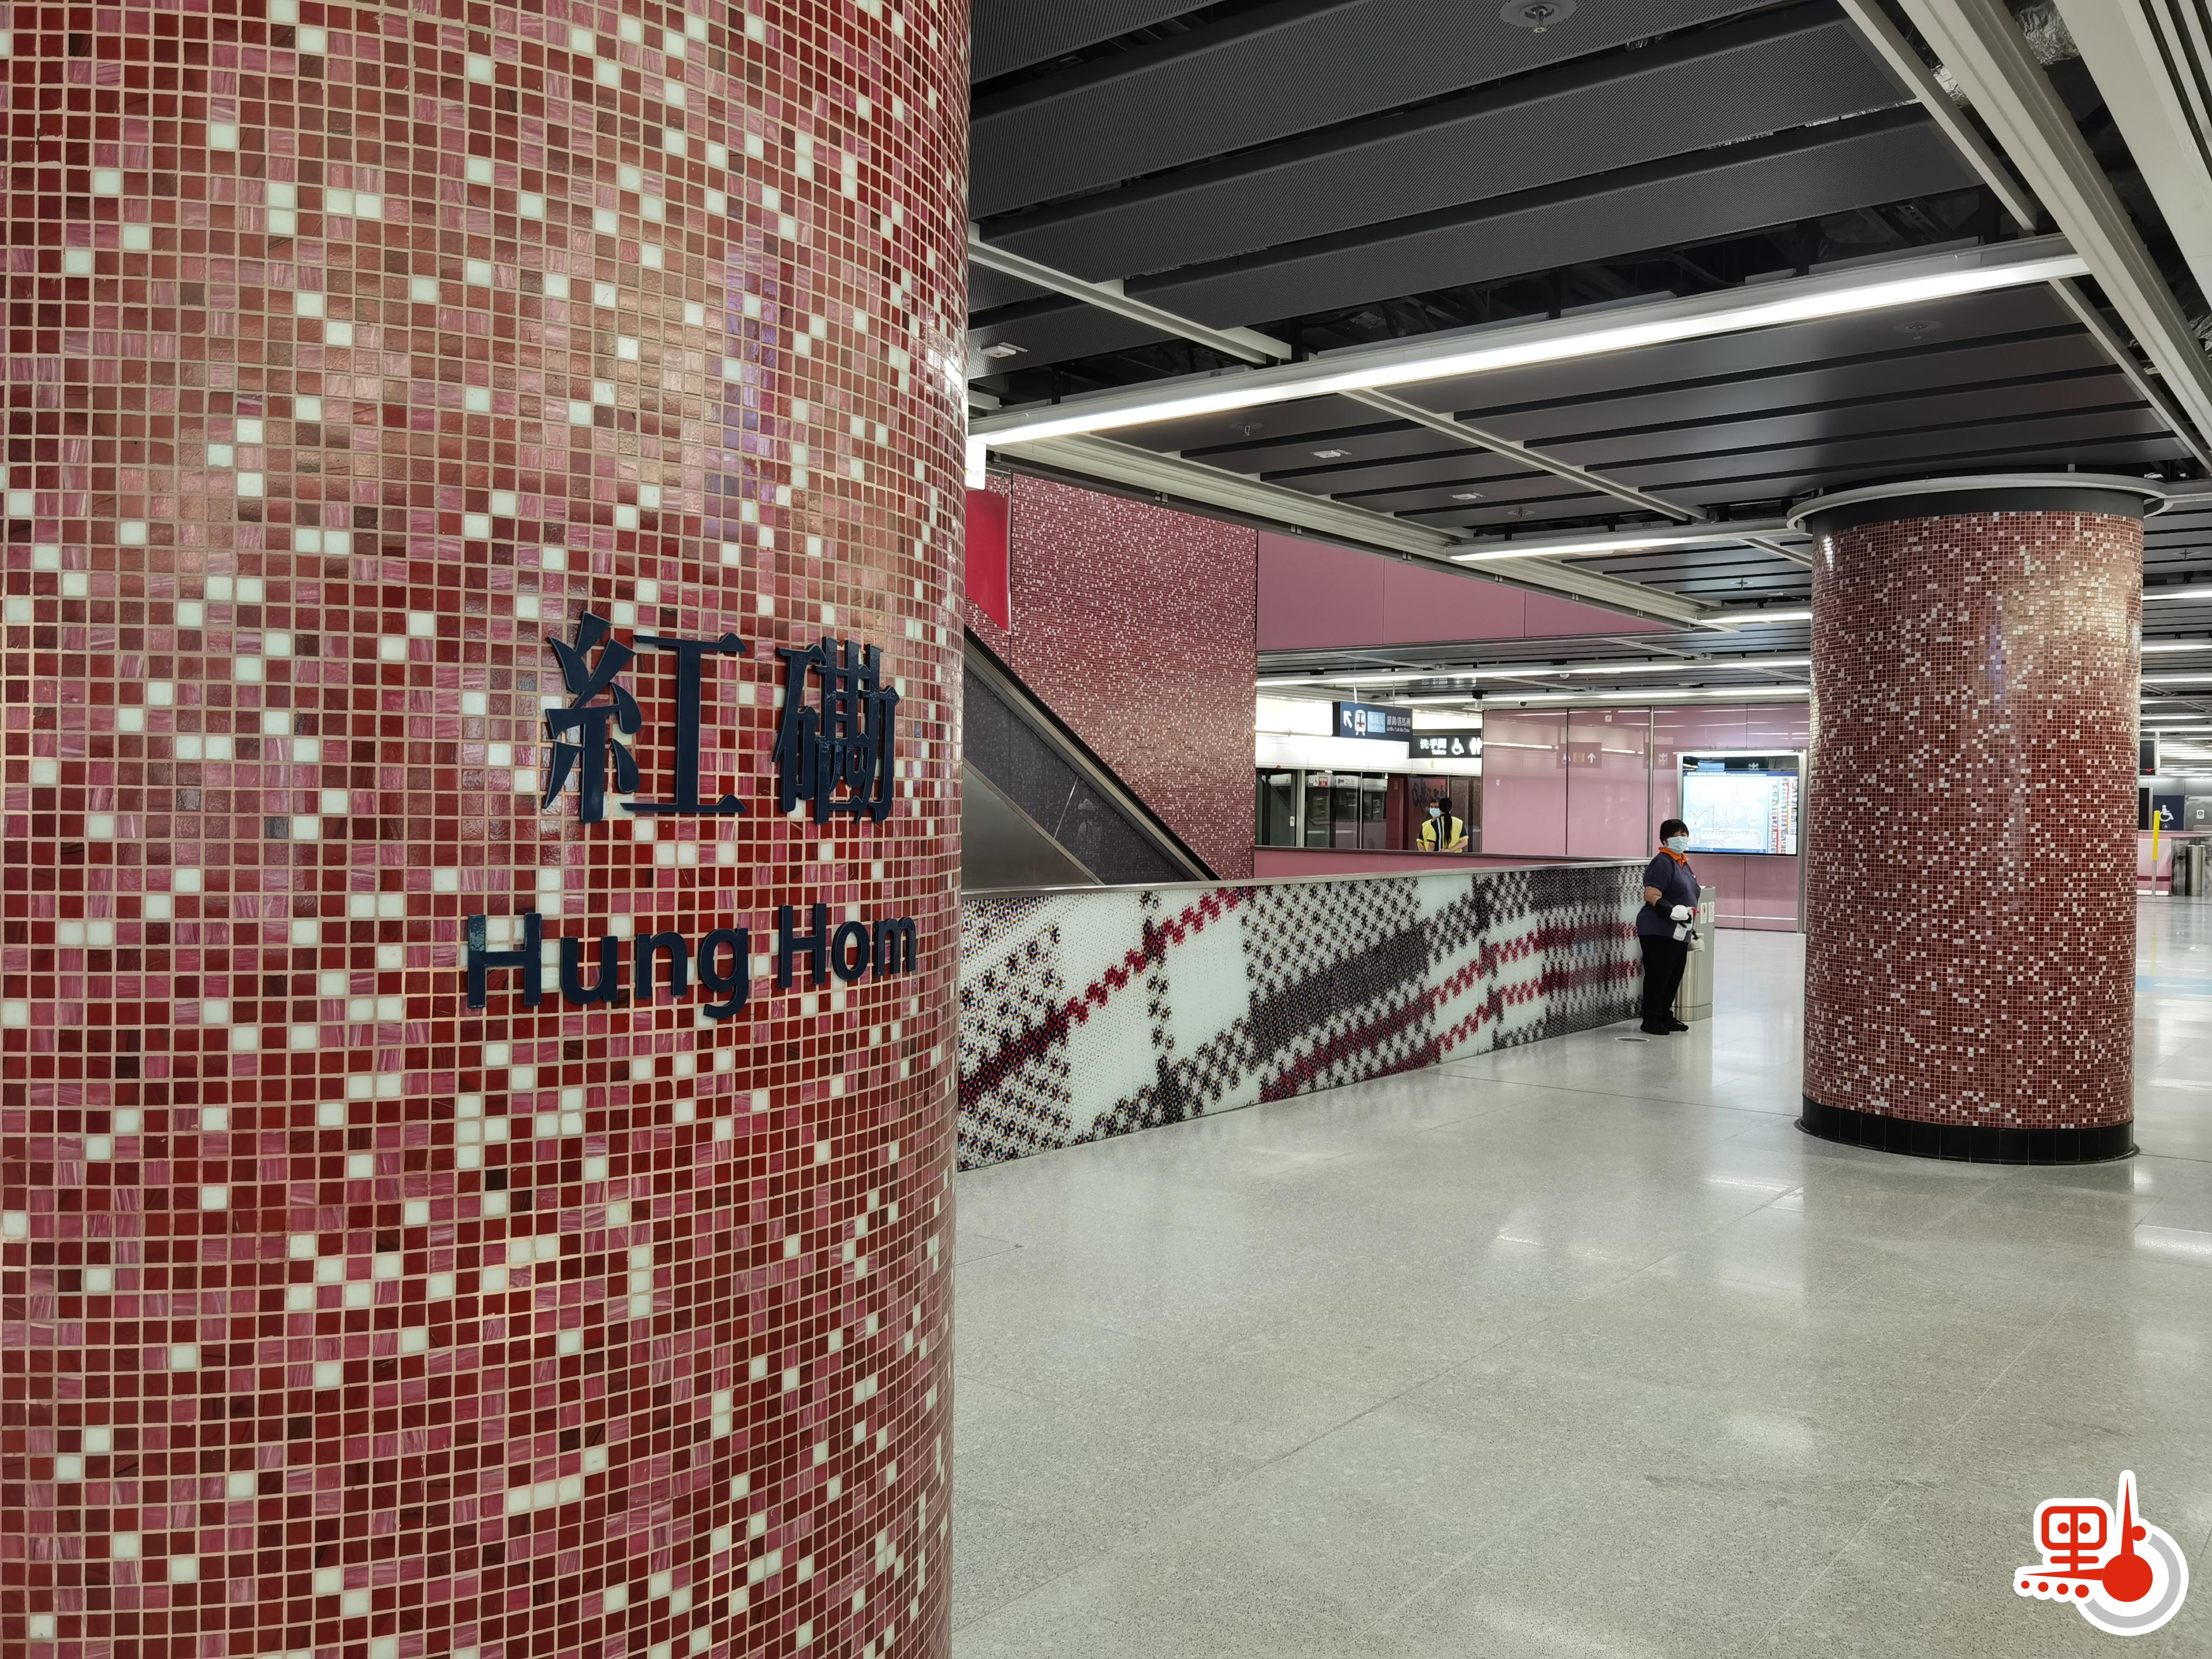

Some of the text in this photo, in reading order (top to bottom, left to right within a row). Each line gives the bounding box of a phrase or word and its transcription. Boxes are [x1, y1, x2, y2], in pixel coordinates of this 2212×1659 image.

[542, 611, 900, 824] 紅磡
[1420, 738, 1447, 749] 洗手間
[467, 903, 918, 1019] Hung Hom
